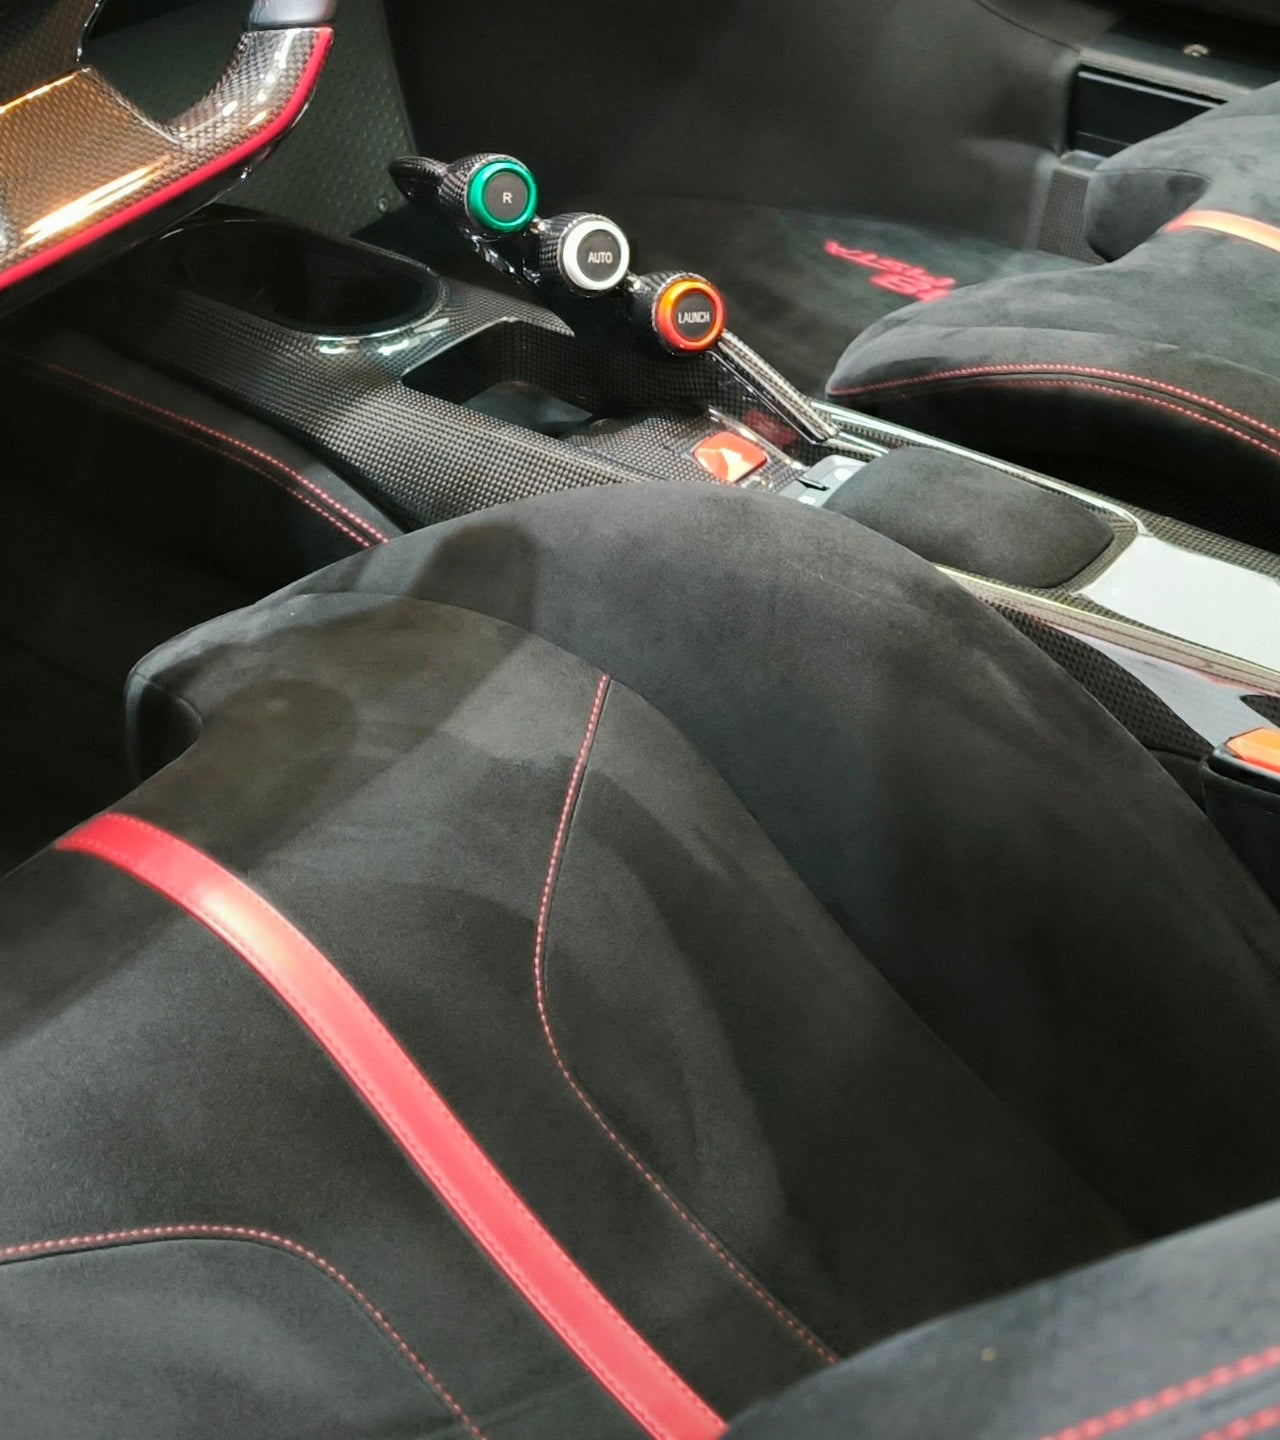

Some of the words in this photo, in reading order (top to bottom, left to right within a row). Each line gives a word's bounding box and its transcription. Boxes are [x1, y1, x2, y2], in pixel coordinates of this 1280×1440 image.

[502, 192, 513, 204] R
[587, 251, 613, 264] AUTO
[678, 310, 711, 325] LAUNCH
